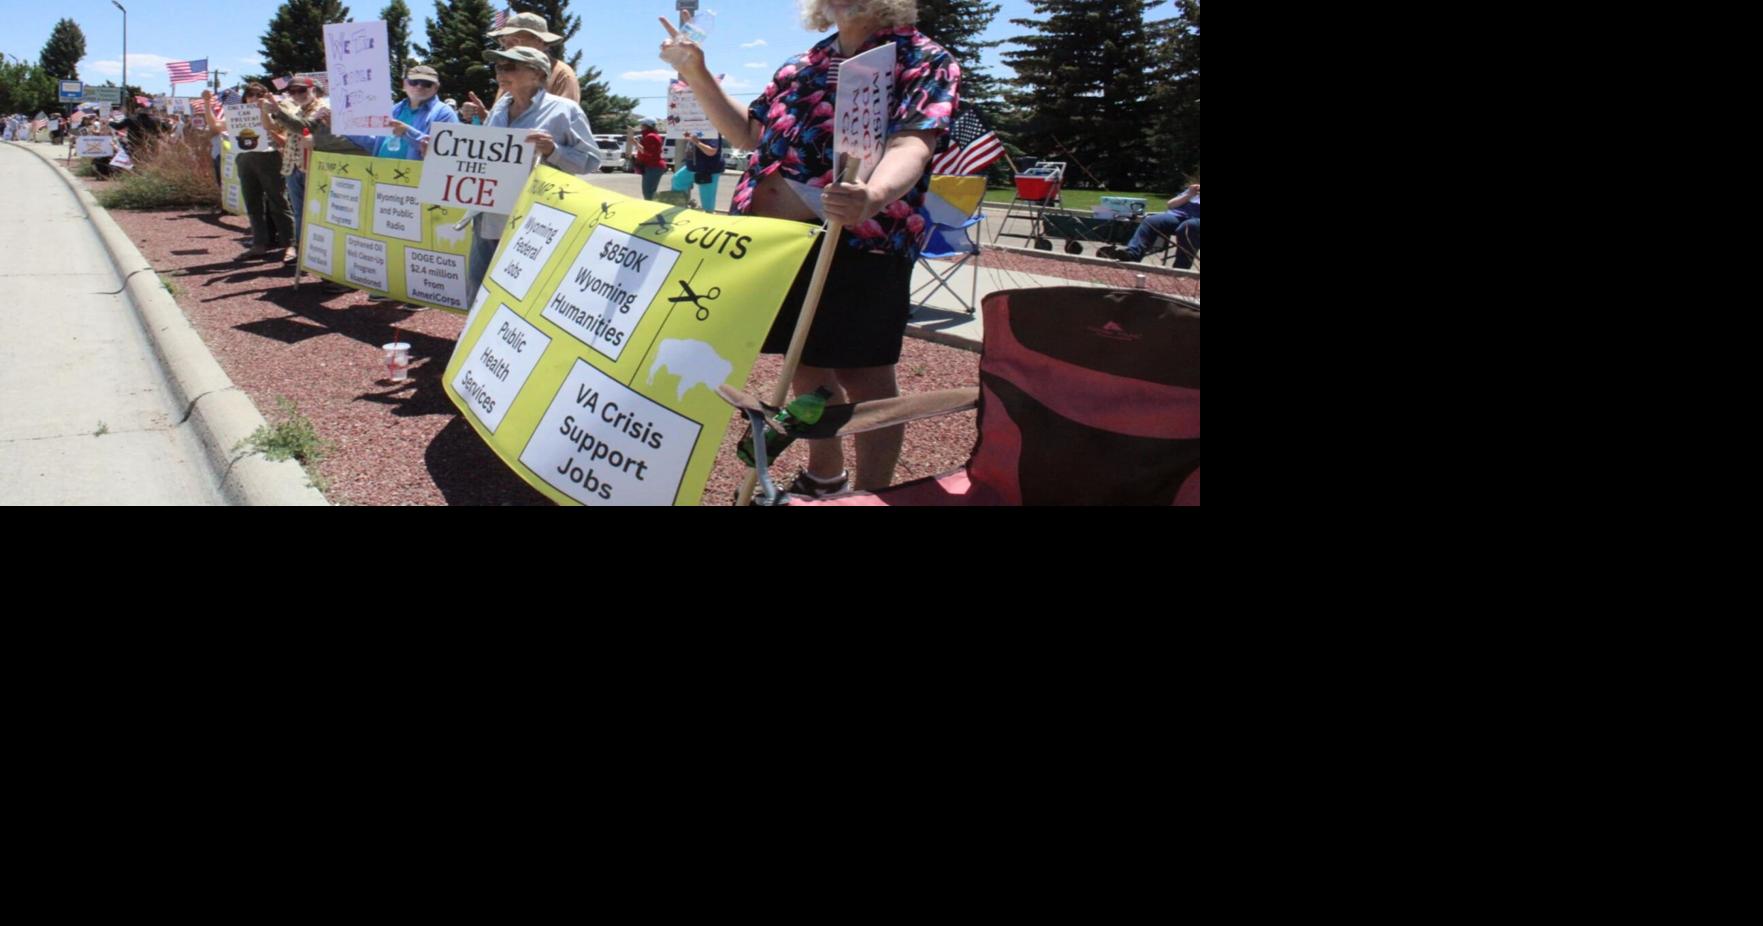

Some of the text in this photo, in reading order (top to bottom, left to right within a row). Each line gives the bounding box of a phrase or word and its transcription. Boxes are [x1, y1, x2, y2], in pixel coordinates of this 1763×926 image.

[852, 88, 860, 155] MUS
[873, 72, 883, 151] MUSK
[433, 129, 524, 165] Crush
[456, 160, 487, 175] THE
[376, 192, 404, 204] Wyoming
[441, 174, 498, 208] ICE
[379, 206, 414, 219] and Public
[386, 220, 406, 232] Radio
[523, 216, 559, 246] Wyoming
[685, 225, 752, 260] CUTS
[411, 251, 457, 267] DOGE Cuts
[513, 237, 542, 262] Federal
[599, 239, 649, 274] $850K
[353, 262, 376, 275] Program
[410, 263, 459, 281] $2.4 million
[423, 279, 445, 291] From
[503, 261, 522, 280] Jobs
[411, 288, 461, 307] AmeriCorps
[574, 266, 638, 314] Wyoming
[550, 293, 626, 347] Humanities
[497, 321, 528, 355] Public
[480, 348, 511, 383] Health
[461, 370, 496, 415] Services
[575, 383, 664, 450] VA Crisis
[559, 415, 649, 482] Support
[556, 457, 614, 501] Jobs
